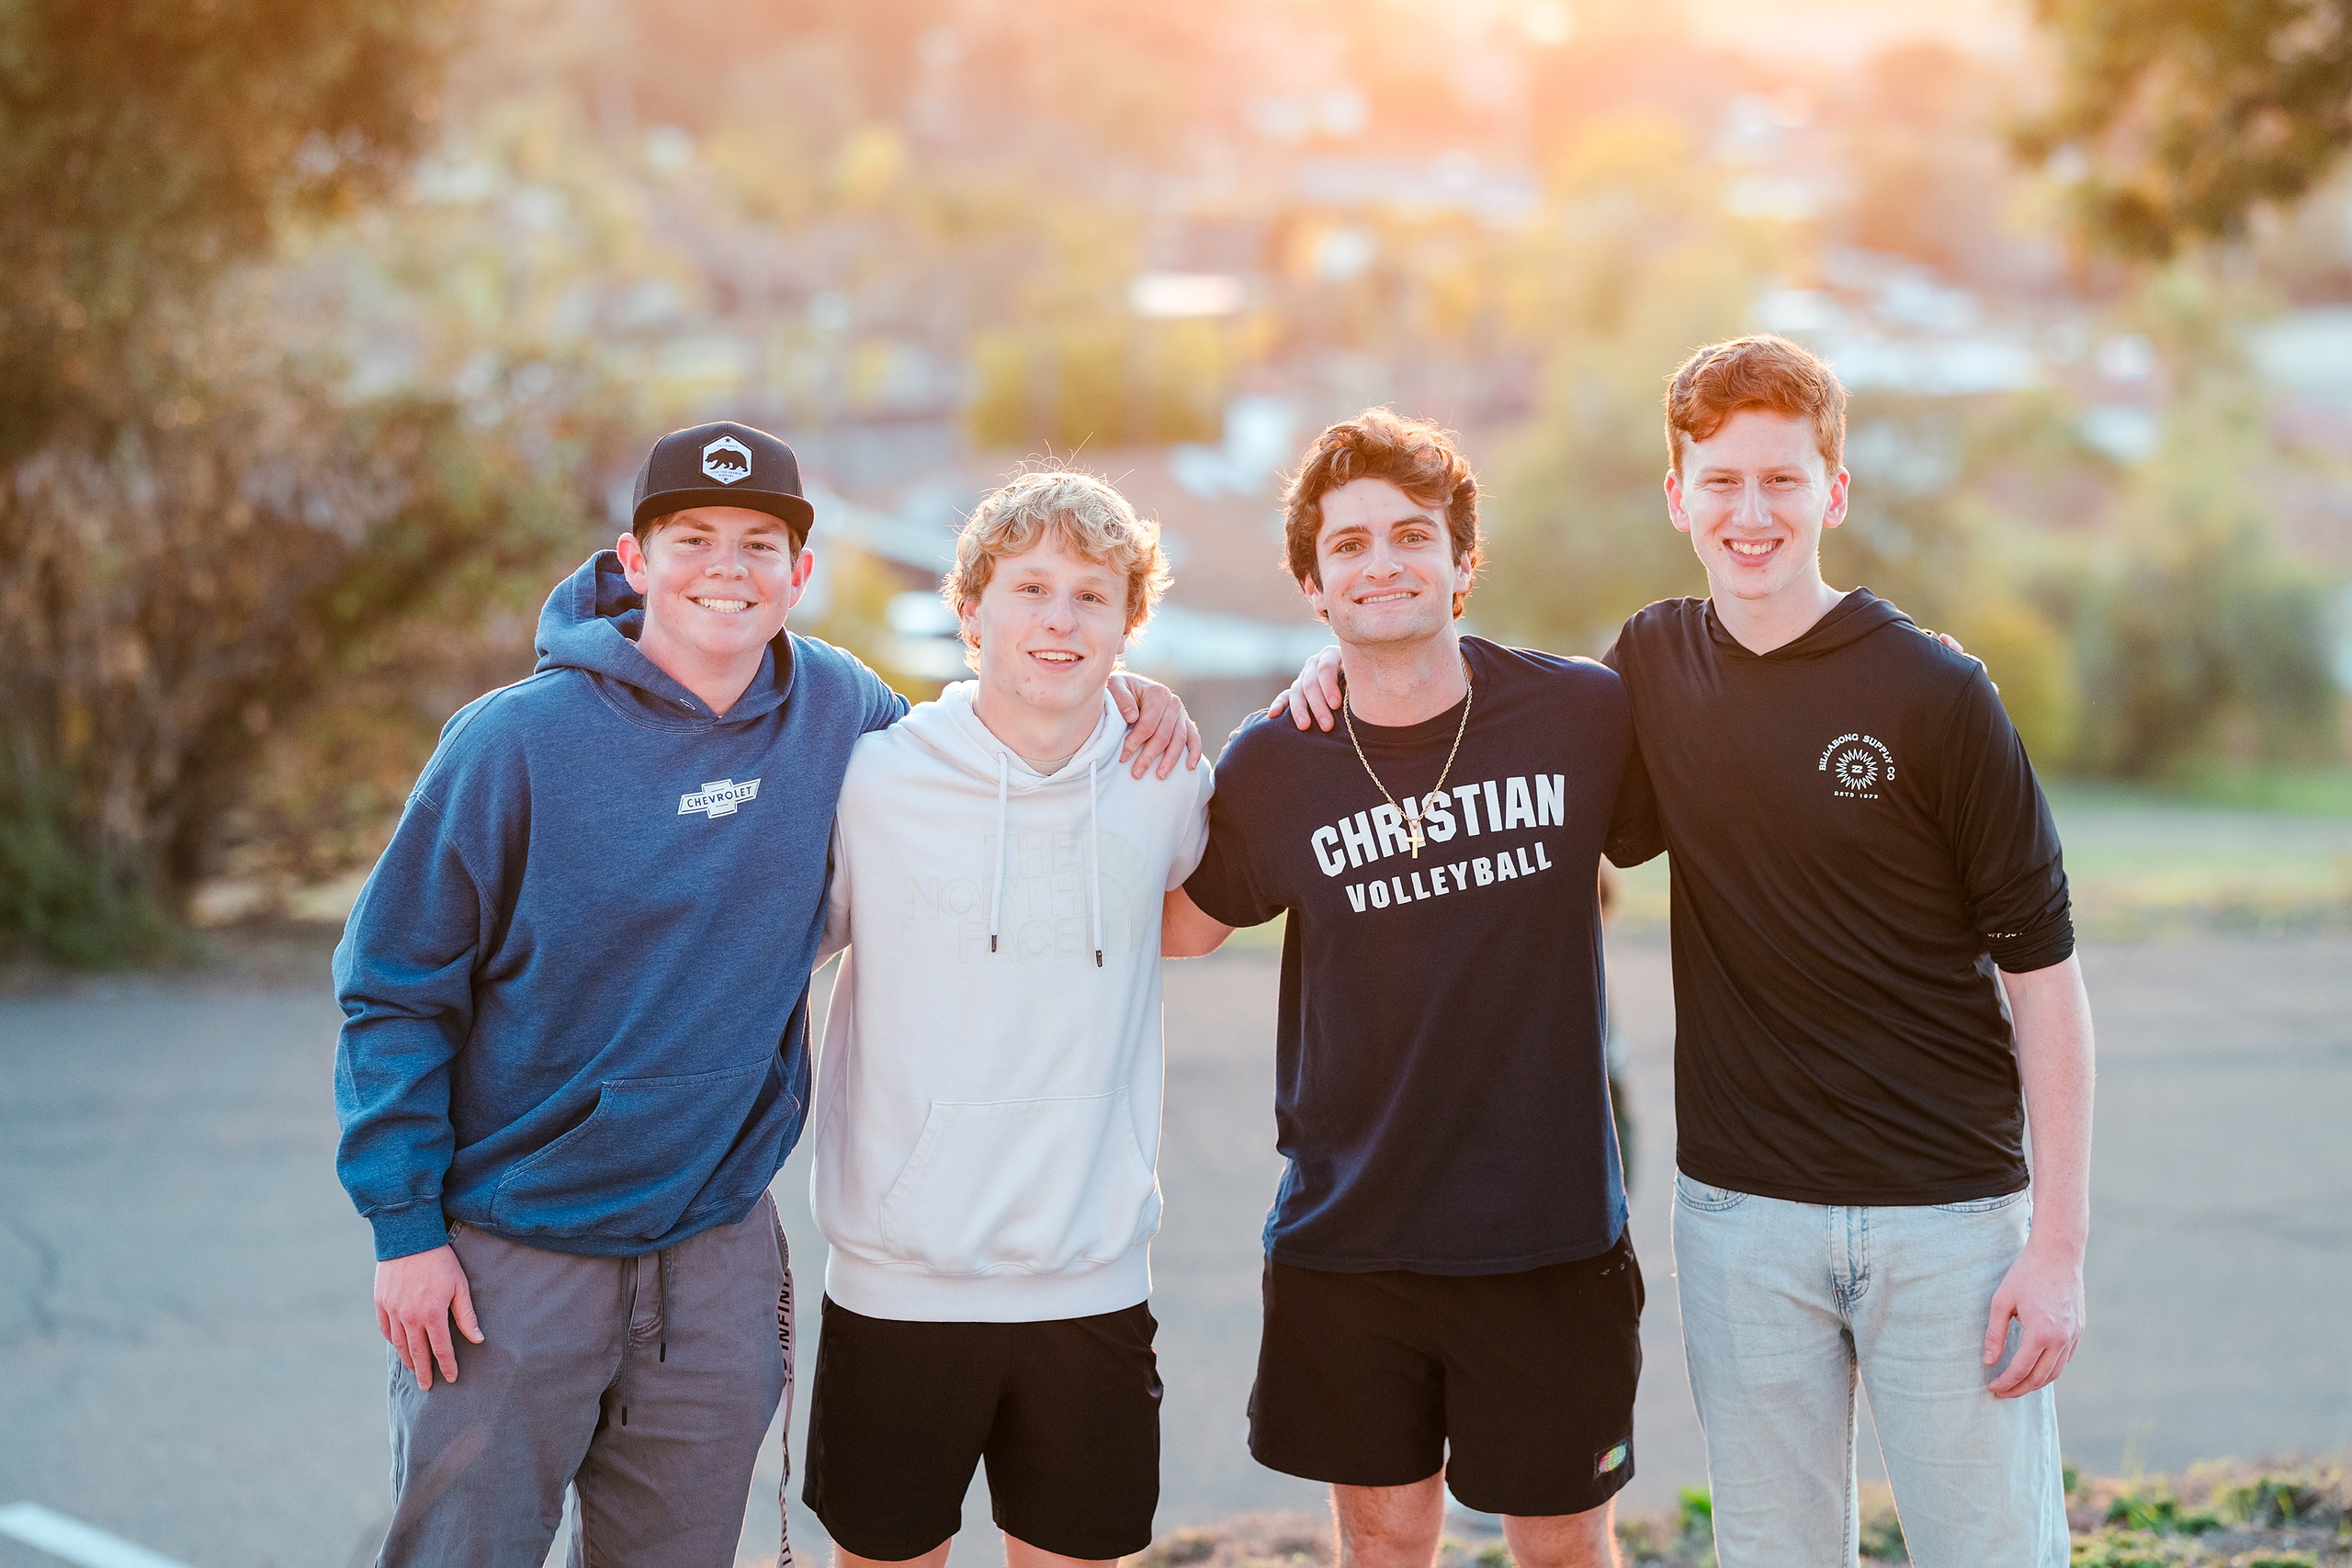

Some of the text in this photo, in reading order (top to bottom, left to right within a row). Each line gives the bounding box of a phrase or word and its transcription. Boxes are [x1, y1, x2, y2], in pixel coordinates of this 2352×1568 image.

[1818, 733, 1895, 781] BILLABONG SUPPLY CO
[687, 785, 752, 807] CHEVROLET
[1310, 773, 1566, 878] CHRISTIAN
[983, 830, 1080, 875] THE
[904, 874, 1083, 920] NORTH
[1345, 841, 1553, 913] VOLLEYBALL
[958, 918, 1086, 964] FACE
